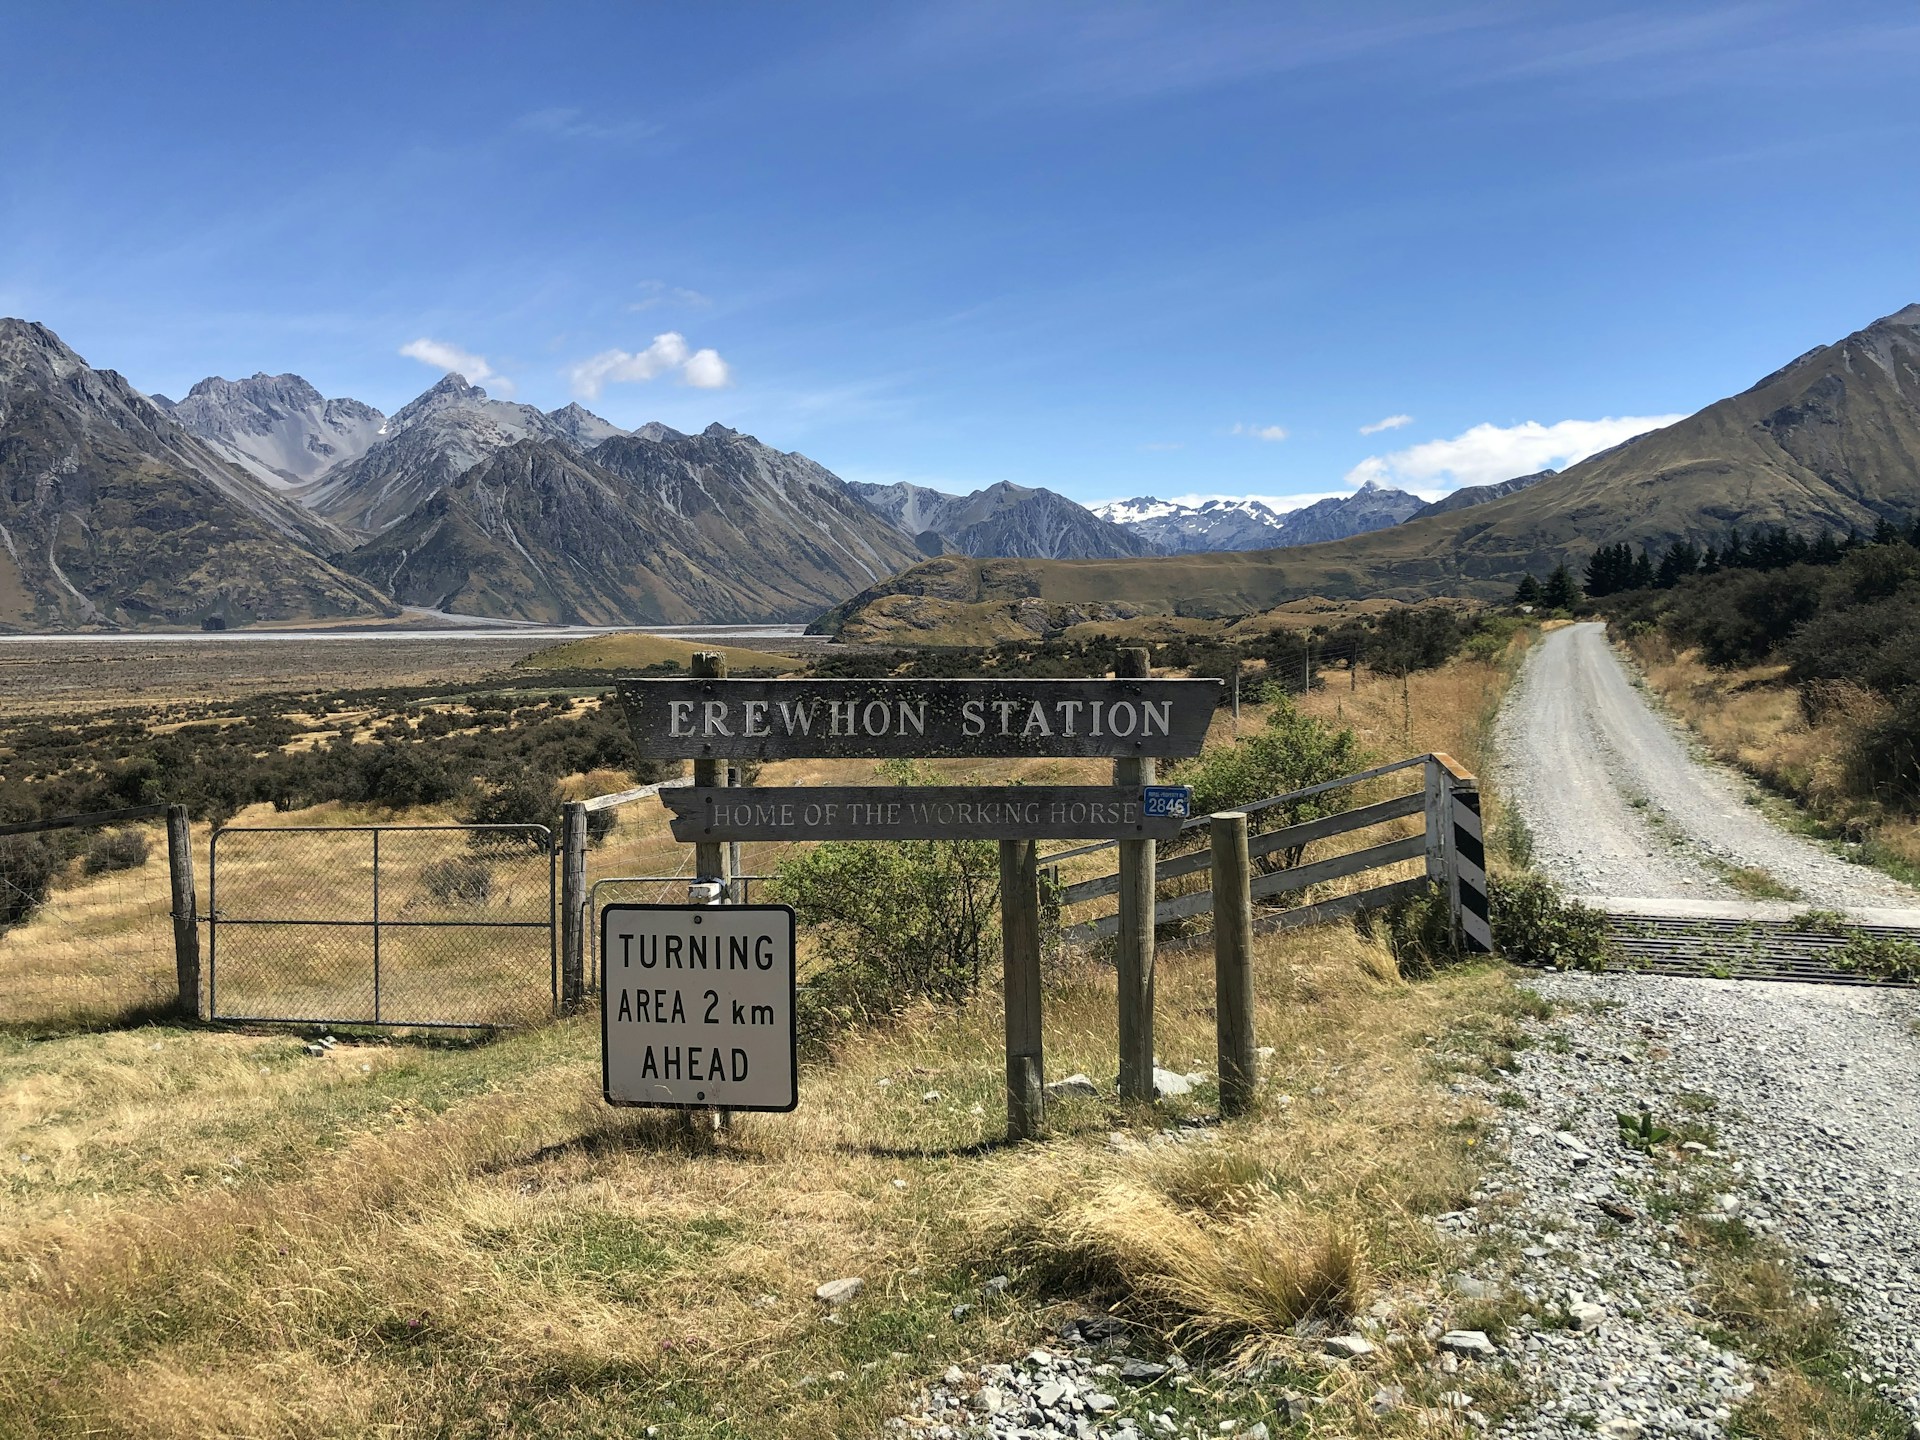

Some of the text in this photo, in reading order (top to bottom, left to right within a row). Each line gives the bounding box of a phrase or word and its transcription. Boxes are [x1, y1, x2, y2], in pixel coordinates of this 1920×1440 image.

[667, 700, 1174, 738] EREWHON STATION
[712, 802, 1137, 827] HOME OF THE WORKING HORSE
[619, 934, 773, 971] TURNING
[618, 988, 775, 1026] AREA 2 km
[641, 1045, 749, 1082] AHEAD
